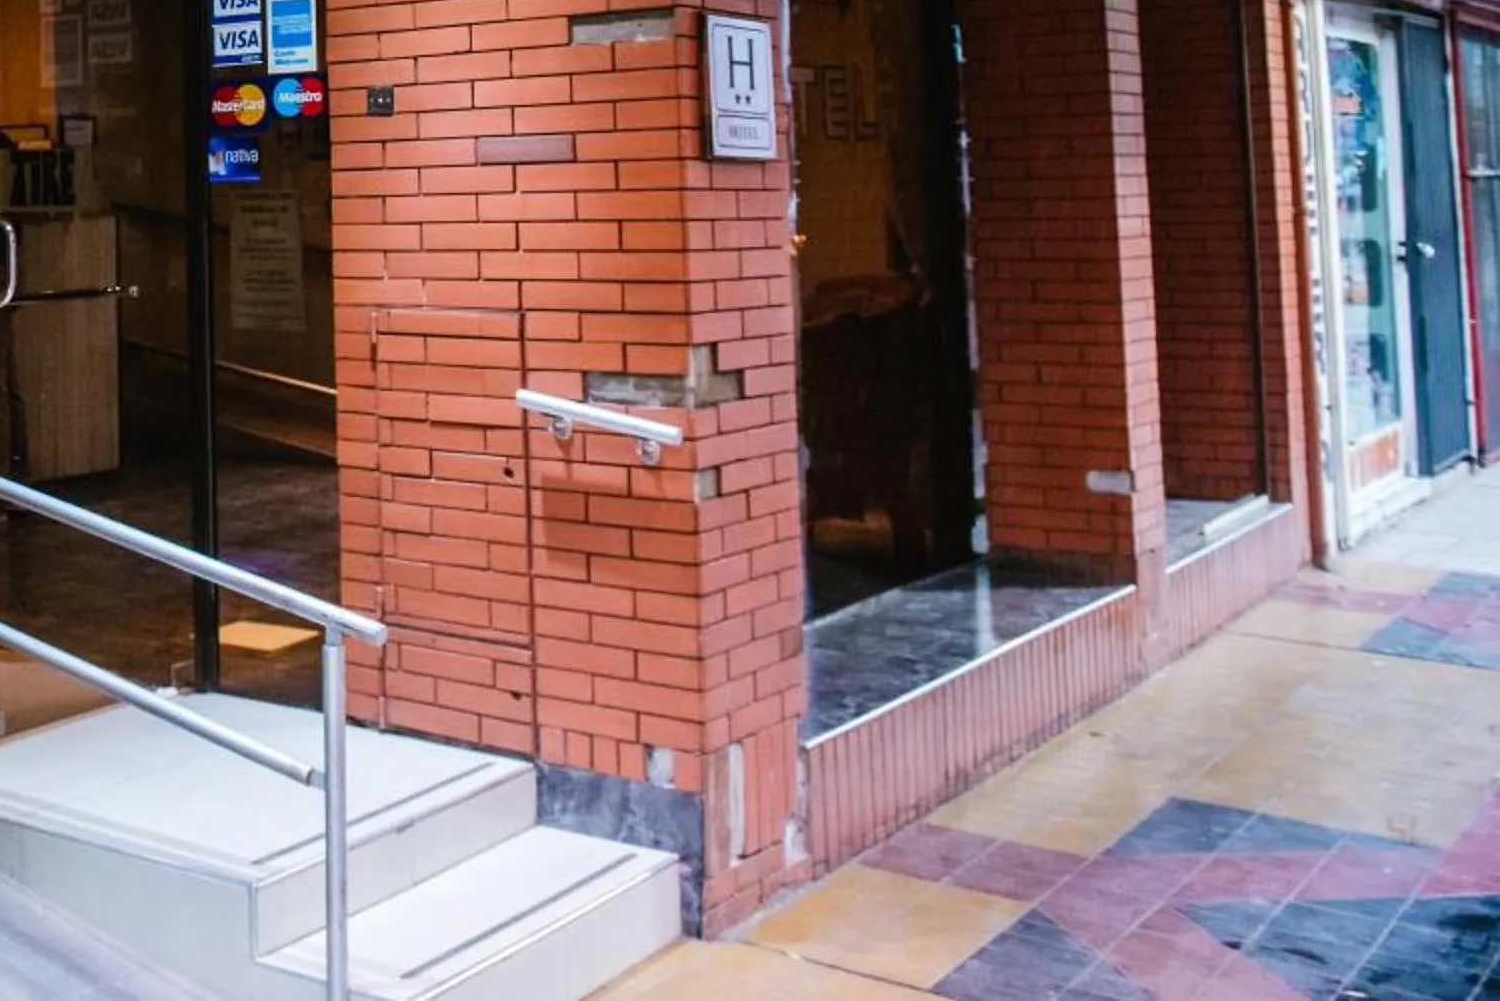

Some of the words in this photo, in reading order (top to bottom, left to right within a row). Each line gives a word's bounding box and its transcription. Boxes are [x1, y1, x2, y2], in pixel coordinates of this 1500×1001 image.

[220, 30, 258, 50] VISA
[727, 35, 756, 91] H
[279, 90, 323, 104] Maestro
[790, 66, 880, 140] TEL
[225, 148, 259, 164] nativa
